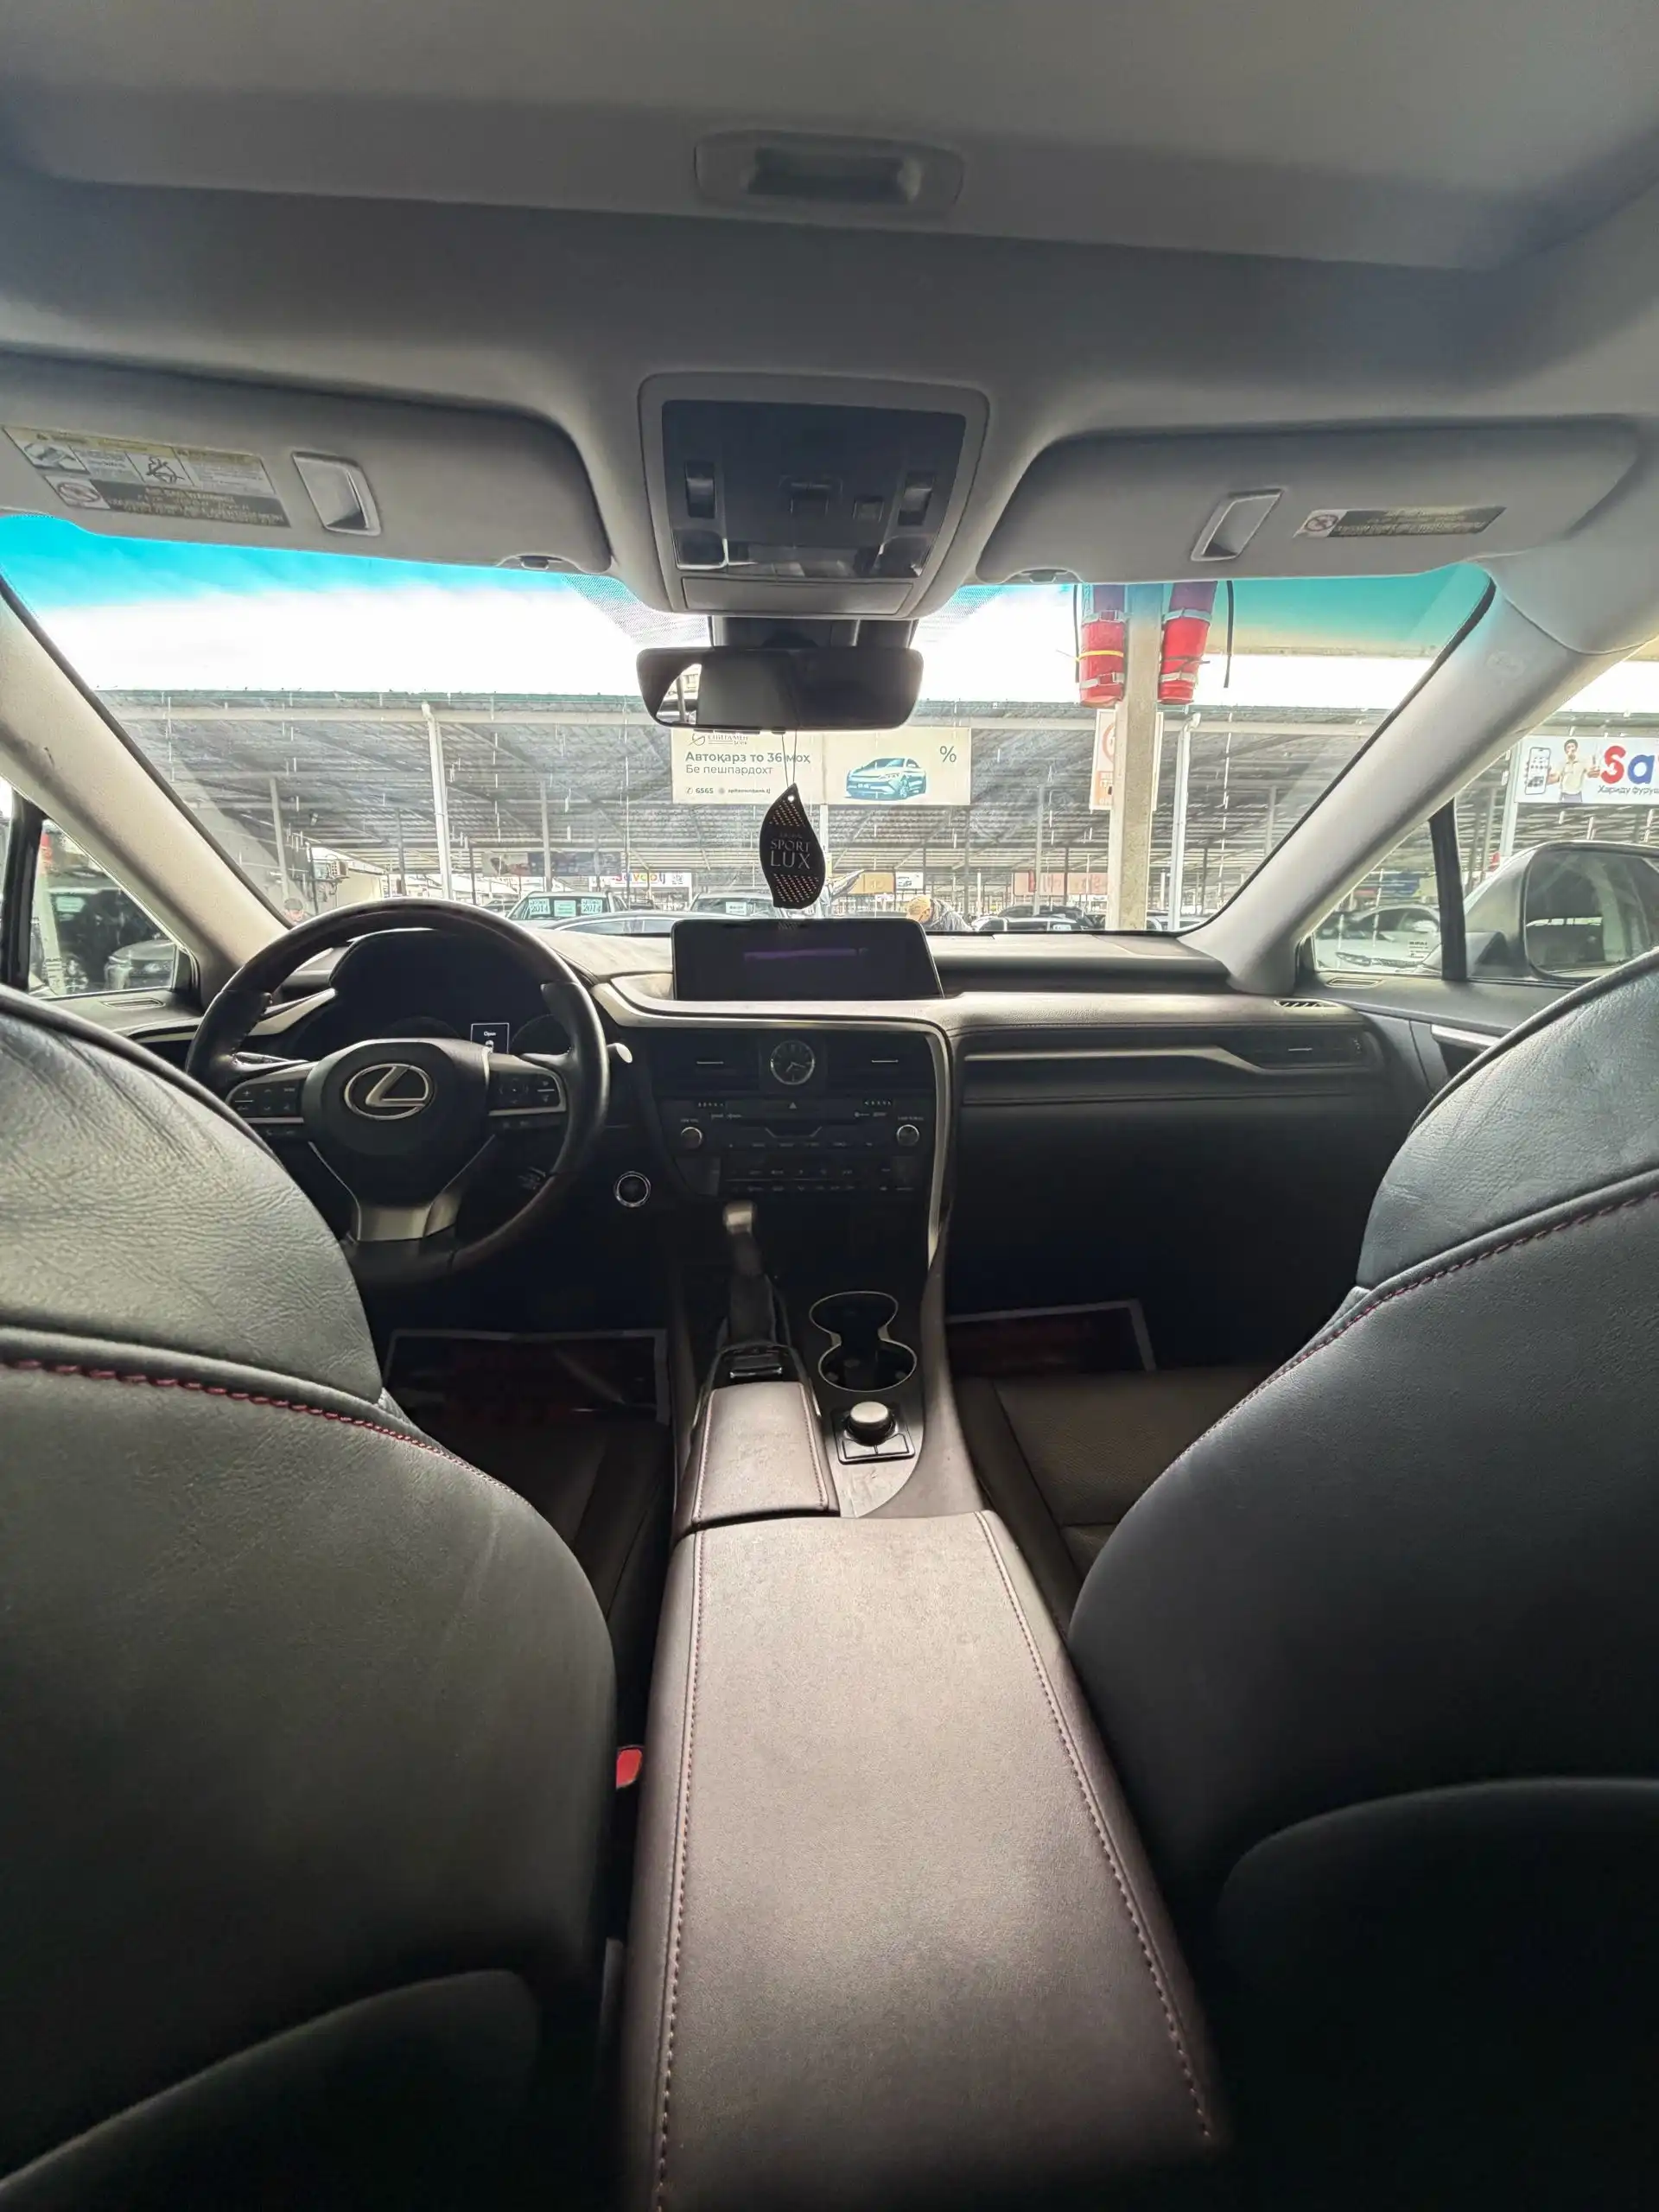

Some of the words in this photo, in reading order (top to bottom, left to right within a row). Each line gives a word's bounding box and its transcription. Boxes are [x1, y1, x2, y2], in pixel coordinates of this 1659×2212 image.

[685, 752, 747, 764] Автоқарз
[767, 753, 782, 762] 36
[939, 745, 957, 763] %
[686, 765, 700, 773] Бе
[703, 766, 773, 776] пешпардохт
[1600, 746, 1659, 785] Sa
[770, 839, 810, 853] SPORT
[771, 850, 810, 869] LUX
